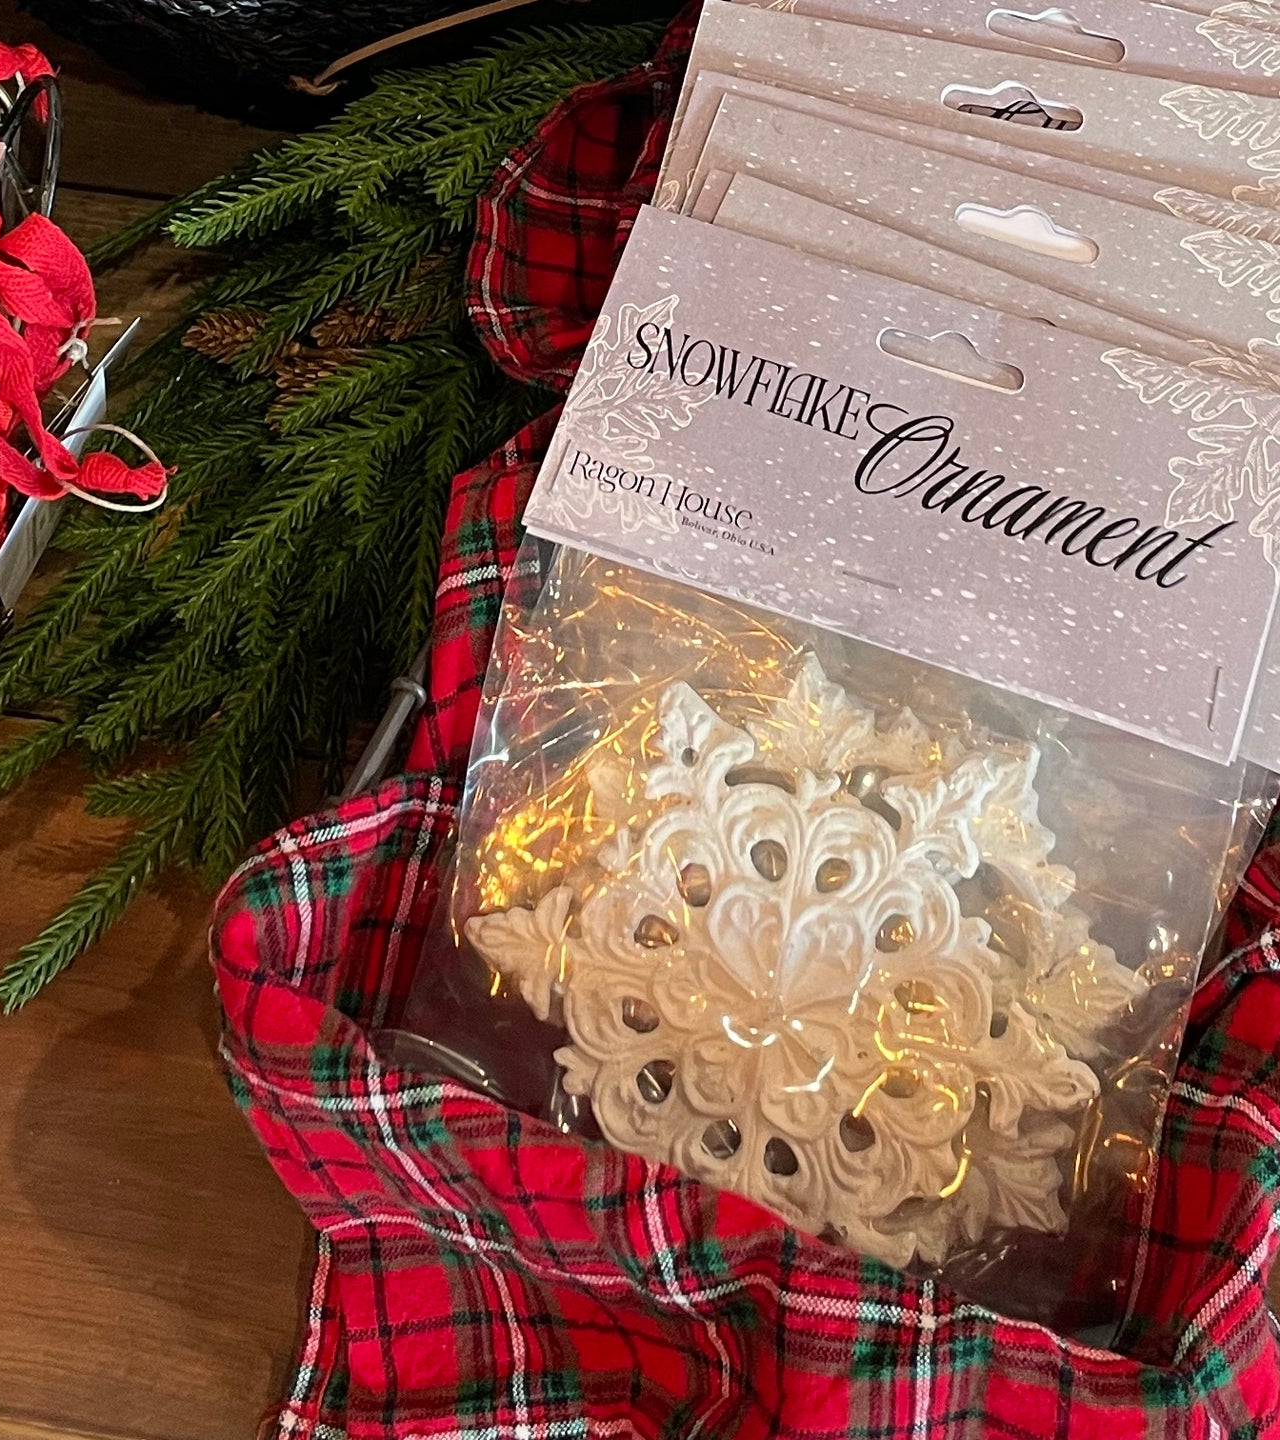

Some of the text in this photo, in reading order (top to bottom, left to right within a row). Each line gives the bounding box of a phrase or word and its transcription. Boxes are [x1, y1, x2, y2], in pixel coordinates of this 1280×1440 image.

[567, 449, 754, 532] Ragon House
[626, 321, 1239, 589] SNOWFLAKE Ornament
[720, 529, 749, 547] Ohio
